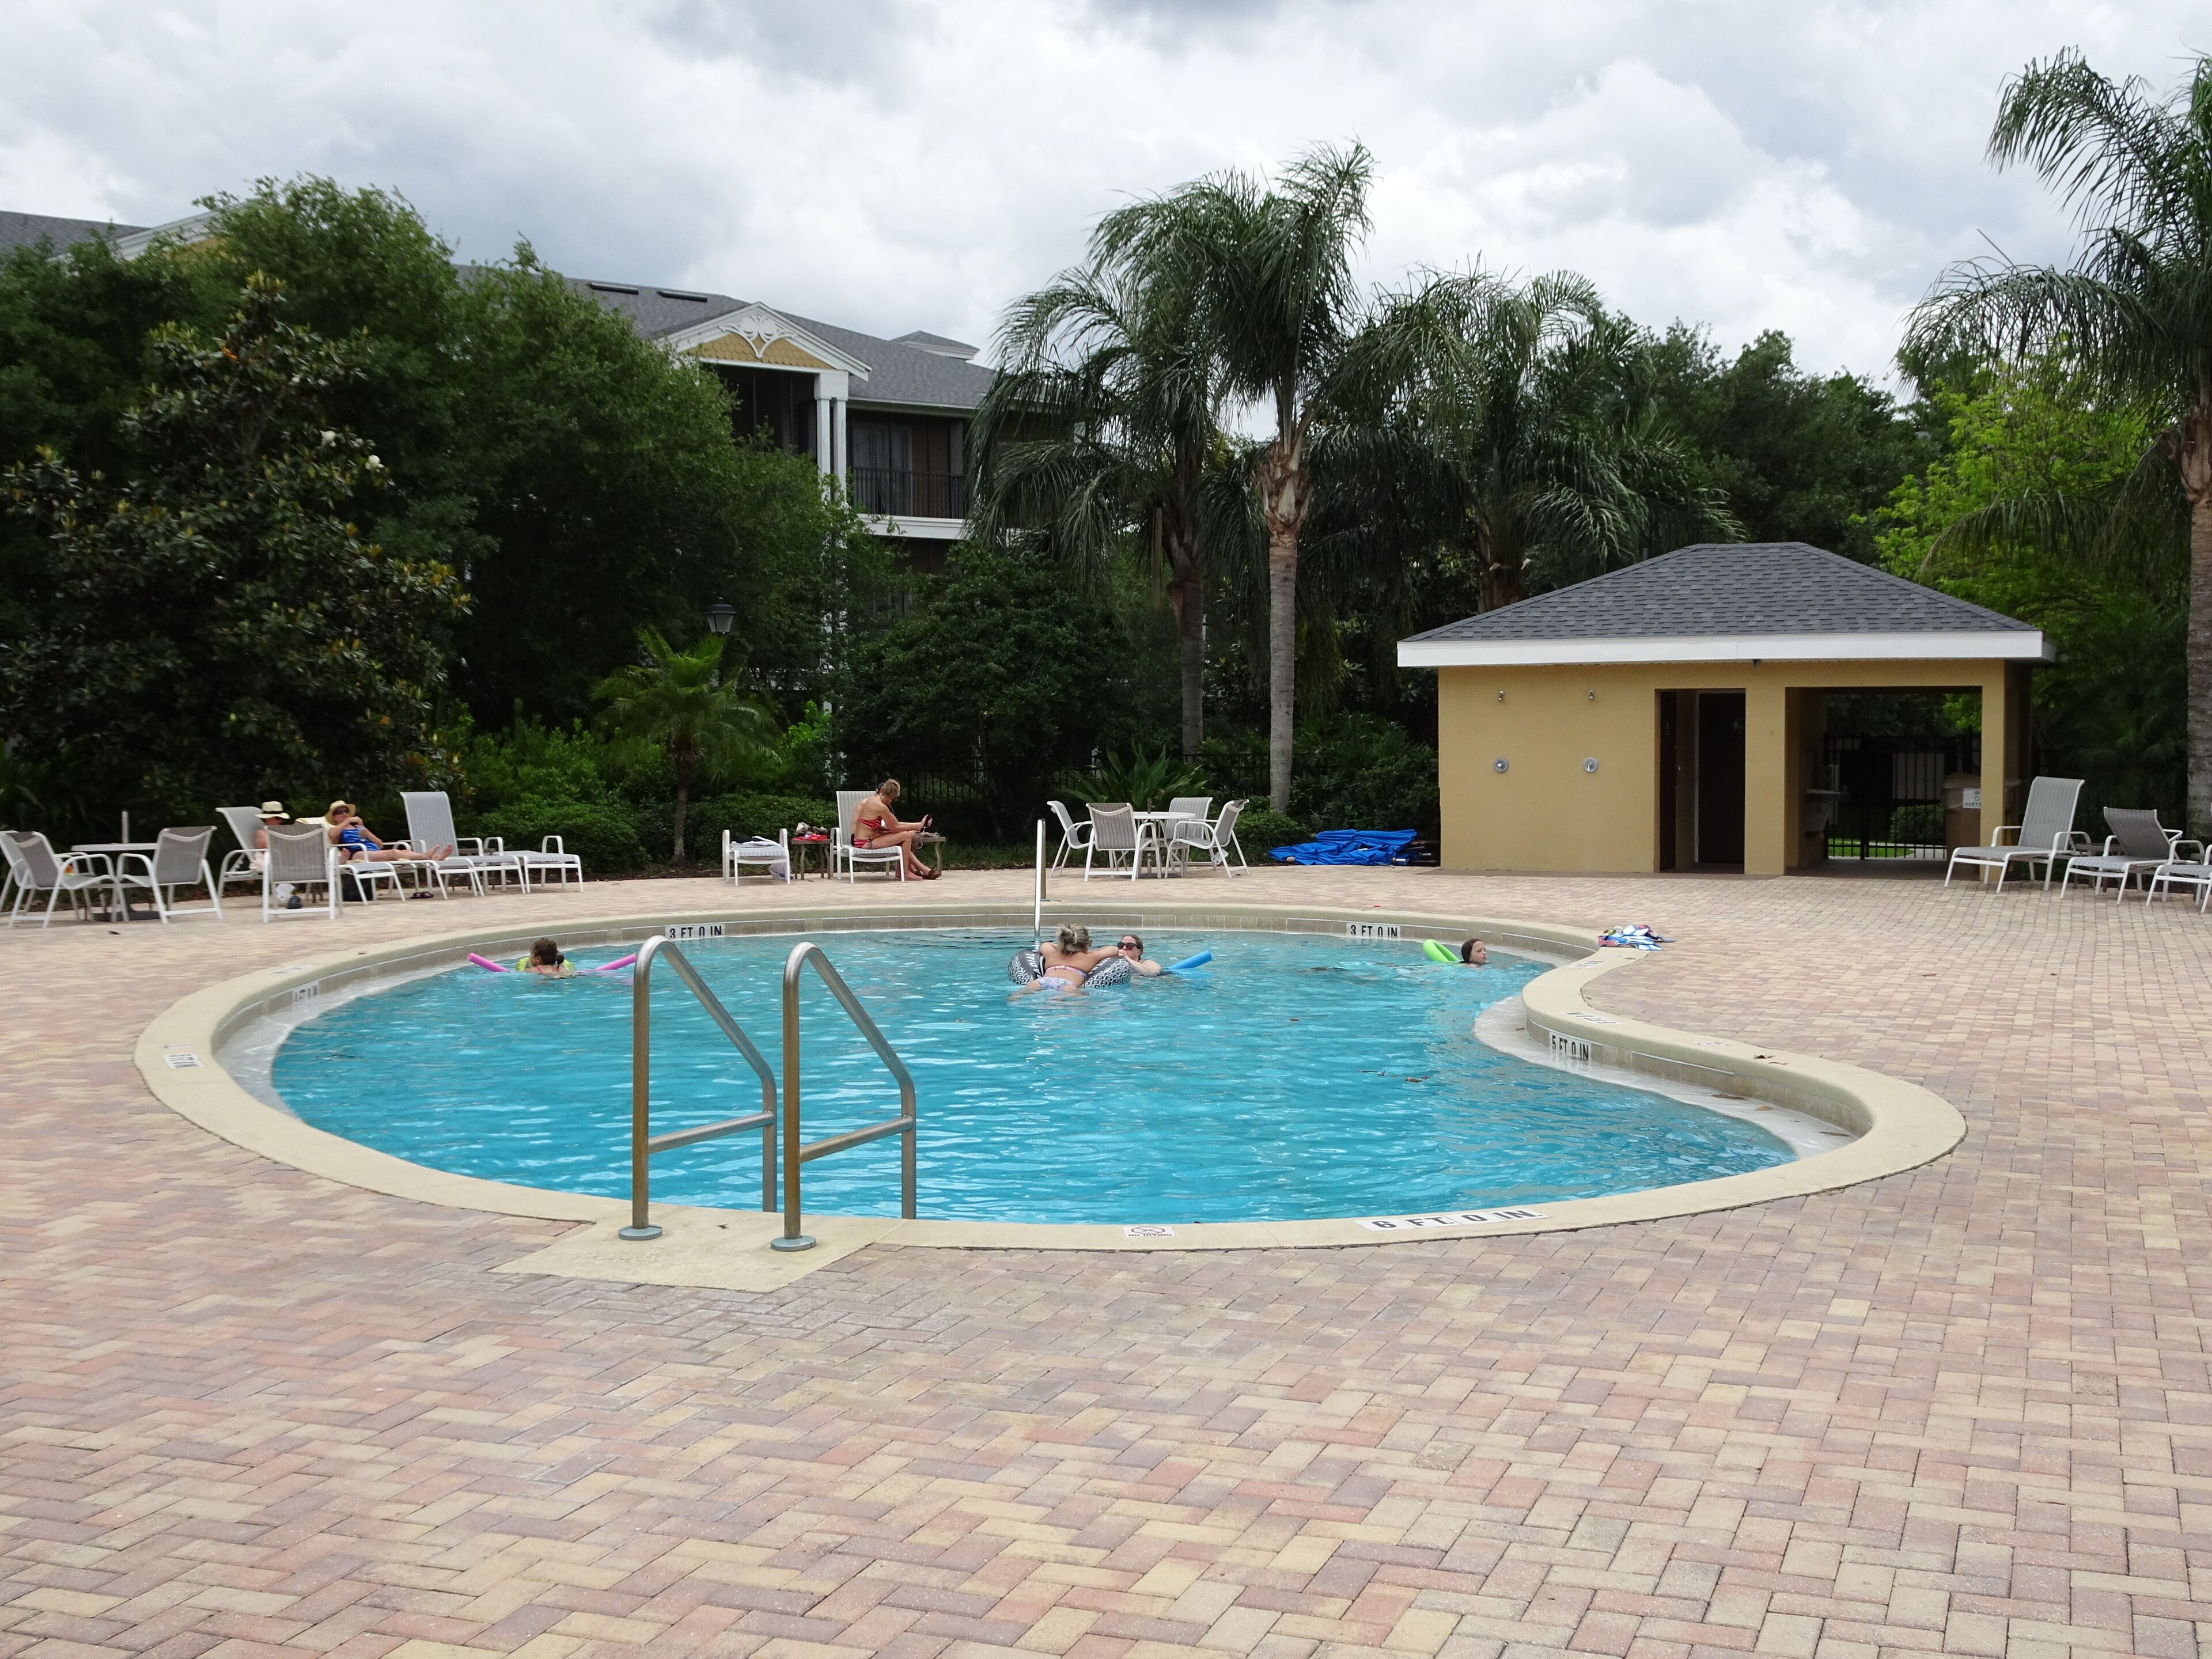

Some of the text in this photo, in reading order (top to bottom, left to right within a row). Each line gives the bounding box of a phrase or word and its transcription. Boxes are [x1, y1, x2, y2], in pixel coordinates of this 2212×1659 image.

[670, 928, 676, 938] 3
[681, 926, 693, 938] FT
[710, 925, 722, 935] IN
[1350, 925, 1357, 935] 3
[1361, 925, 1373, 937] FT
[1387, 927, 1397, 937] IN
[1552, 1035, 1556, 1050] 5
[1559, 1037, 1567, 1054] FT
[1580, 1043, 1589, 1061] IN
[1405, 1216, 1455, 1226] FT.
[1493, 1210, 1544, 1219] IN.
